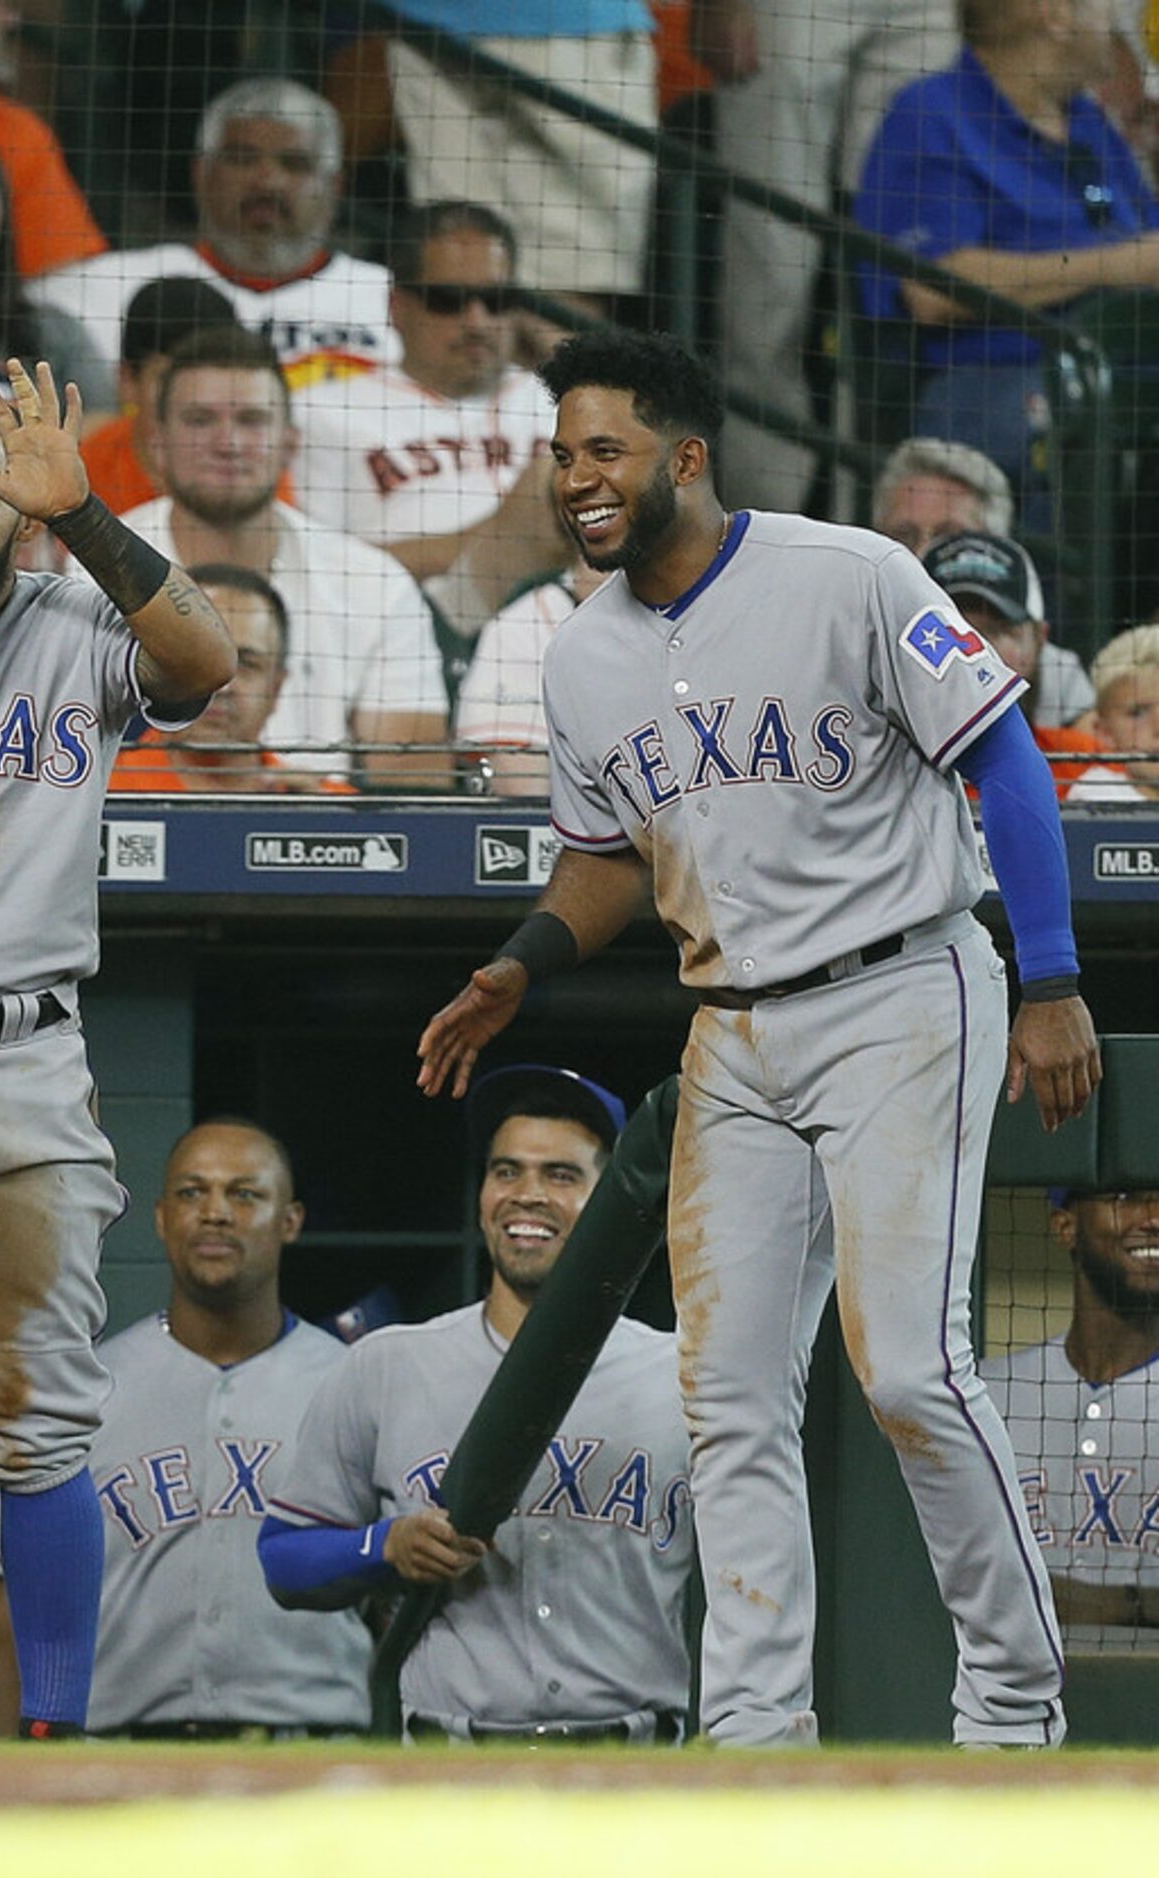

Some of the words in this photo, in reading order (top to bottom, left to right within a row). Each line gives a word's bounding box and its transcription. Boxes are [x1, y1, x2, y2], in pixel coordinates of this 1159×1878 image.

[600, 696, 857, 832] TEXAS
[117, 850, 157, 868] ERA
[253, 839, 362, 864] MLB.com
[1101, 850, 1159, 875] MLB.
[95, 1436, 281, 1549] TEX
[402, 1436, 693, 1552] TXAS
